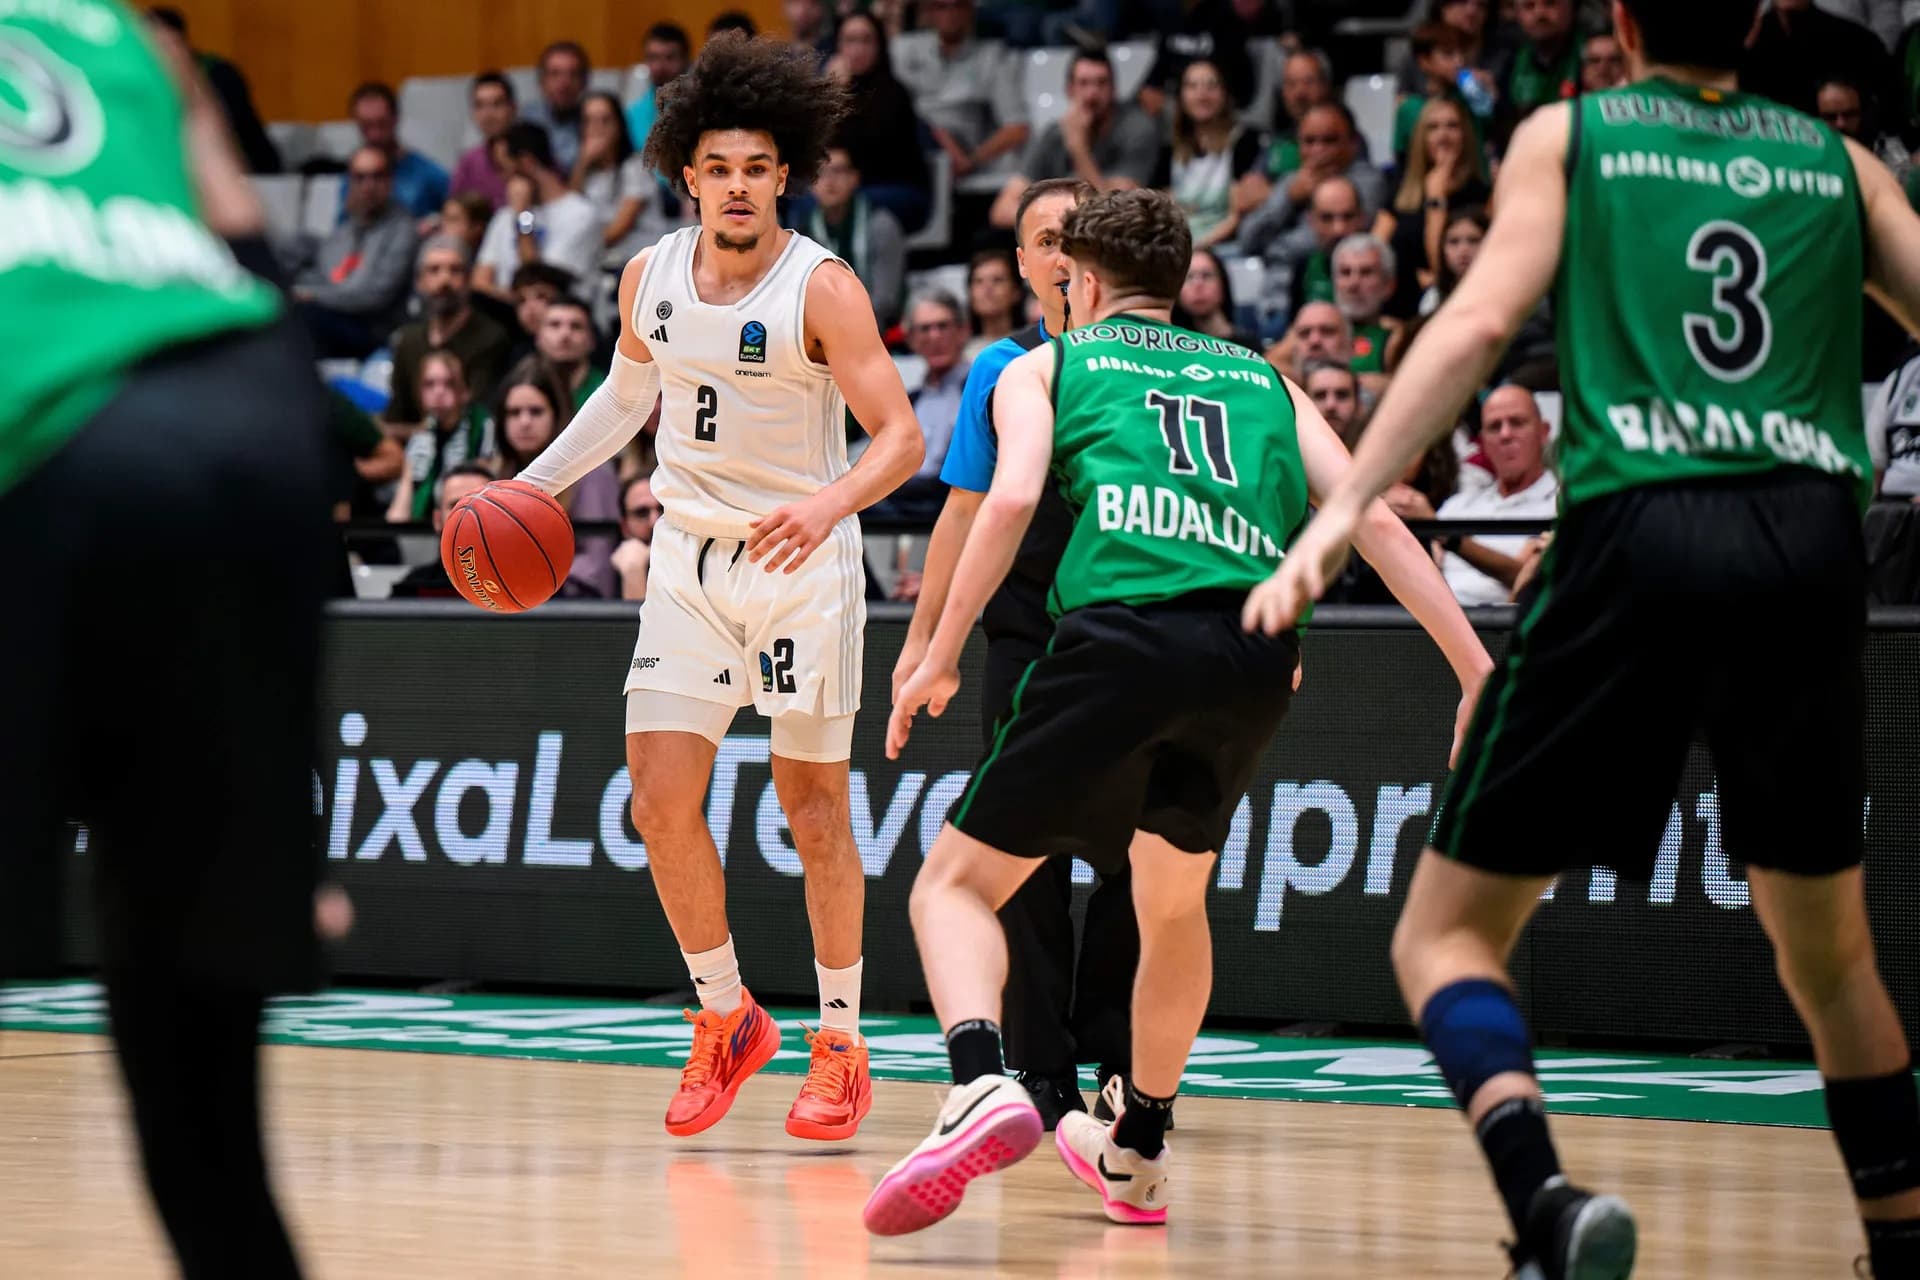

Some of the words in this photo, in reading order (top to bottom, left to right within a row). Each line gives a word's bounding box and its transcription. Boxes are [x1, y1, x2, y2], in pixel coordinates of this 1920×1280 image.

[1599, 93, 1825, 148] BUSQUETS
[1600, 151, 1722, 186] BADALONA
[1774, 166, 1844, 197] FUTUR
[1682, 219, 1773, 383] 3
[734, 369, 772, 378] oneteam
[740, 353, 764, 361] EuroCup
[1086, 355, 1176, 379] BADALONA
[694, 384, 718, 442] 2
[1145, 388, 1238, 488] 11
[773, 638, 797, 693] 2
